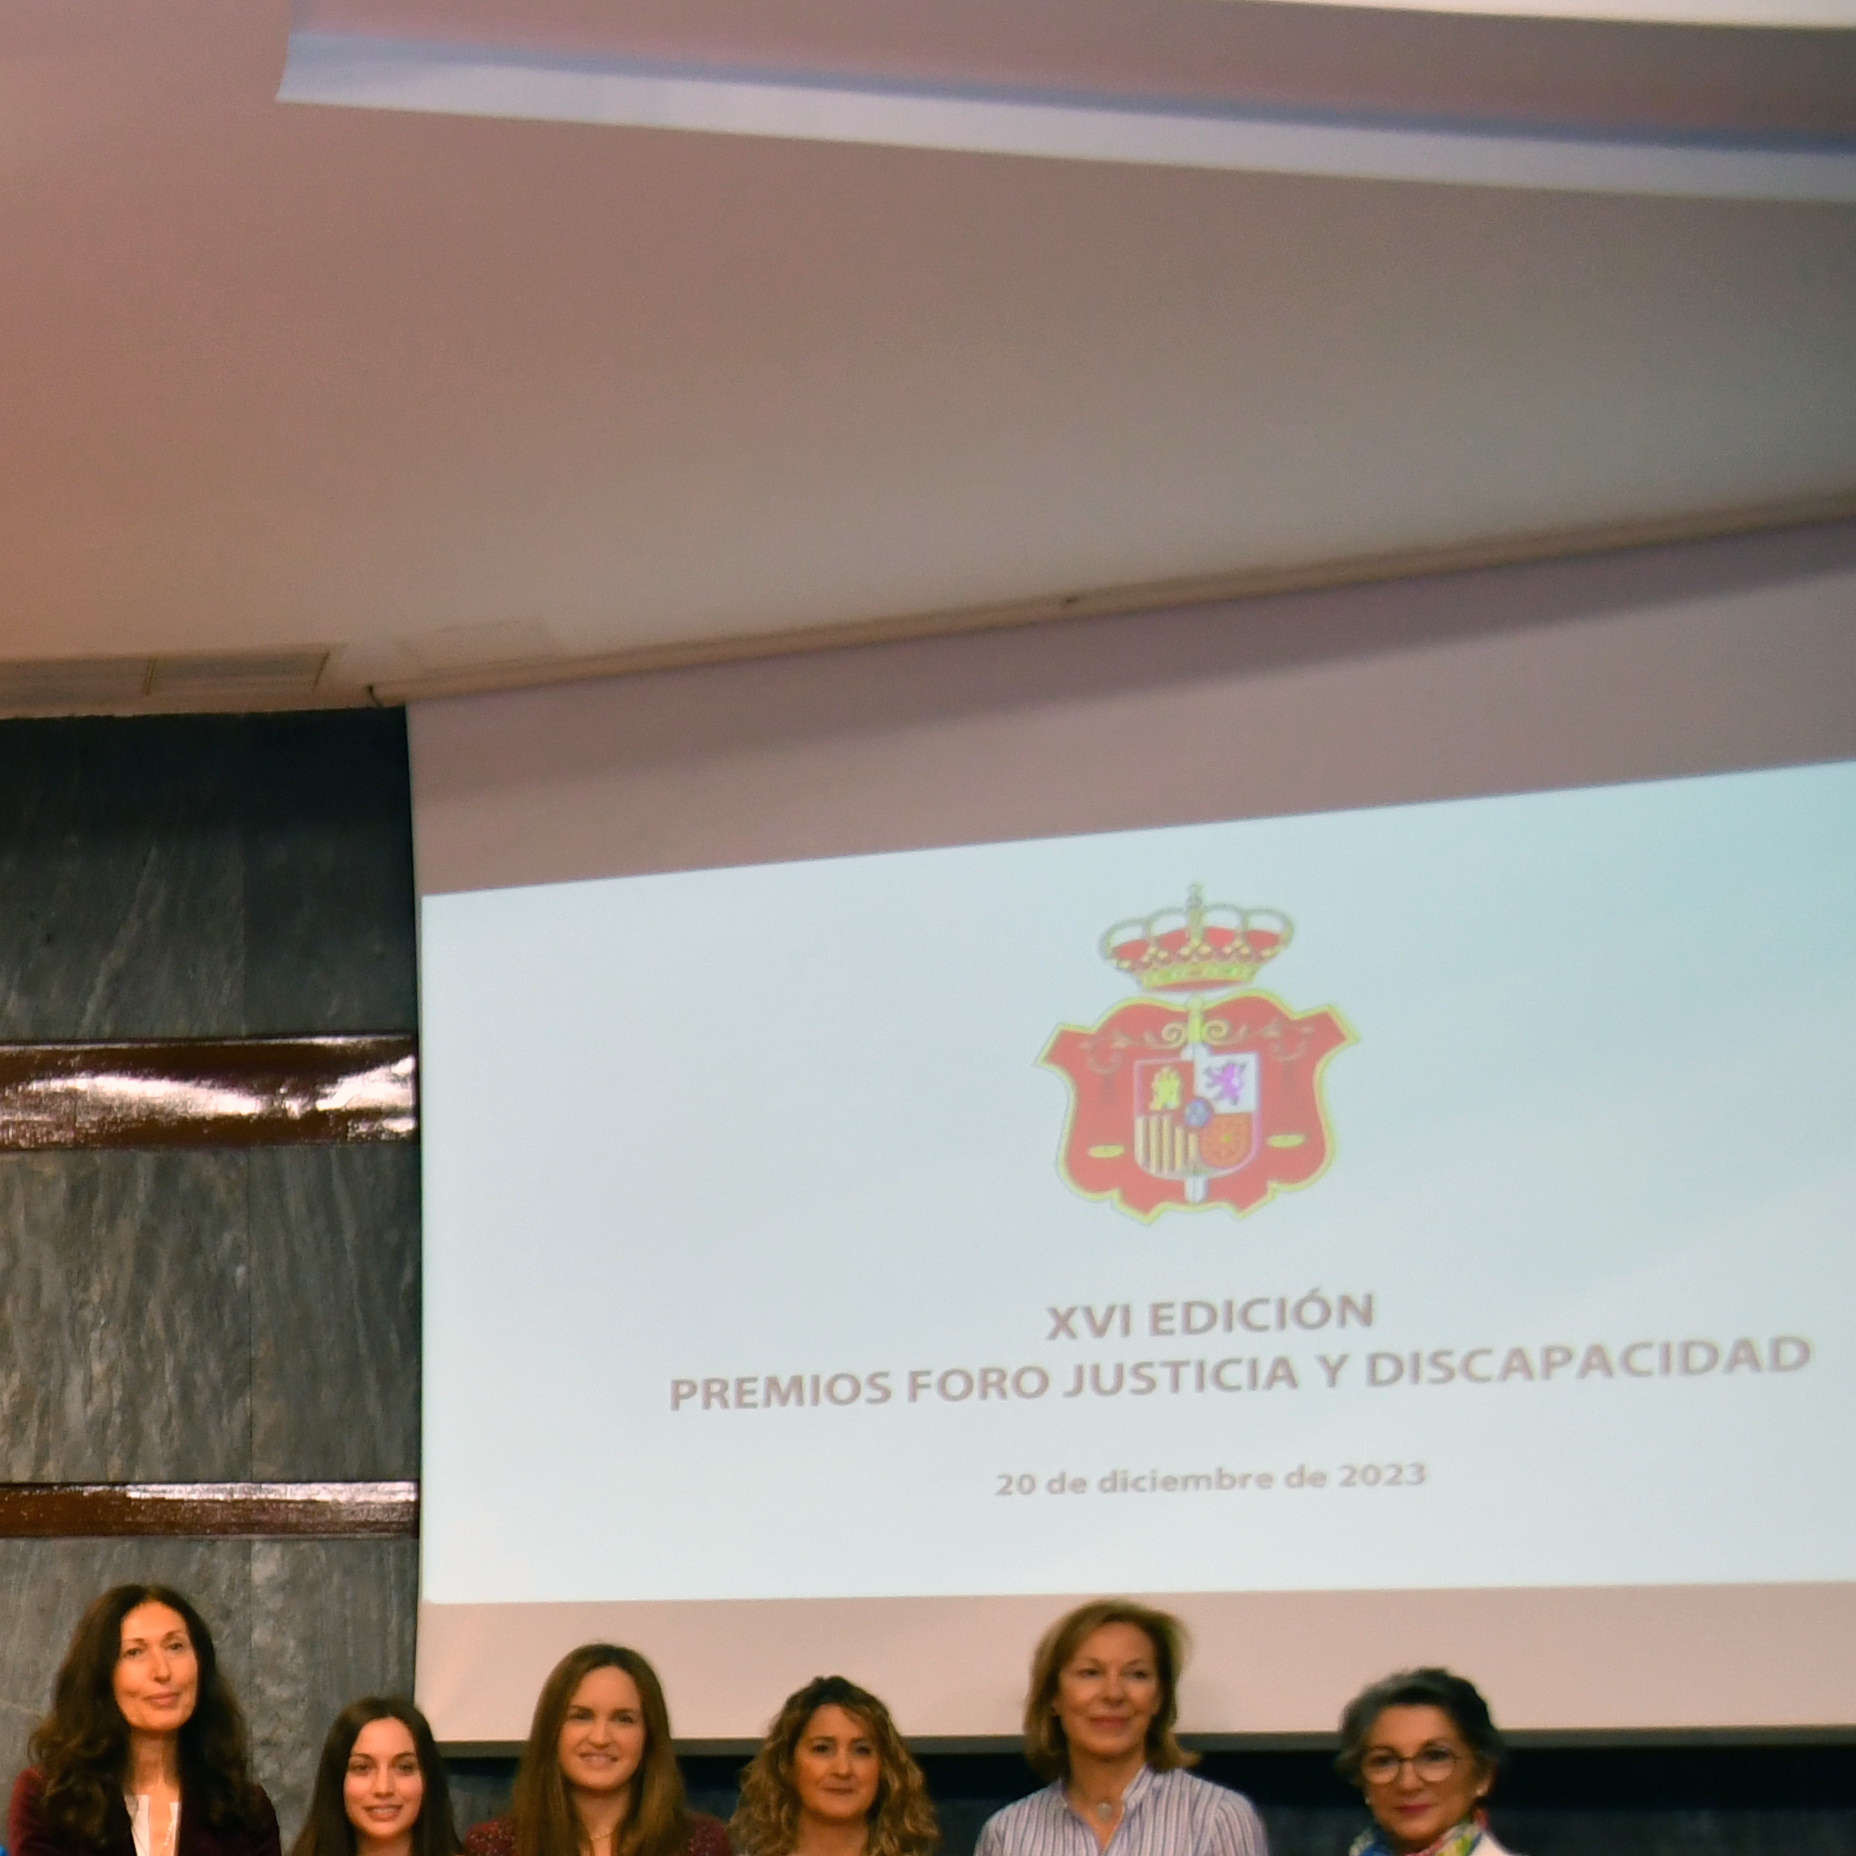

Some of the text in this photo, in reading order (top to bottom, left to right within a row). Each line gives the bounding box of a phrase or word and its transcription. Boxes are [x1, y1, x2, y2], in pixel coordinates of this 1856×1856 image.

[1048, 1288, 1374, 1340] XVI EDICIÓN
[671, 1335, 1813, 1411] PREMIOS FORO JUSTICIA Y DISCAPACIDAD
[997, 1462, 1427, 1496] 20 de diciembre de 2023
